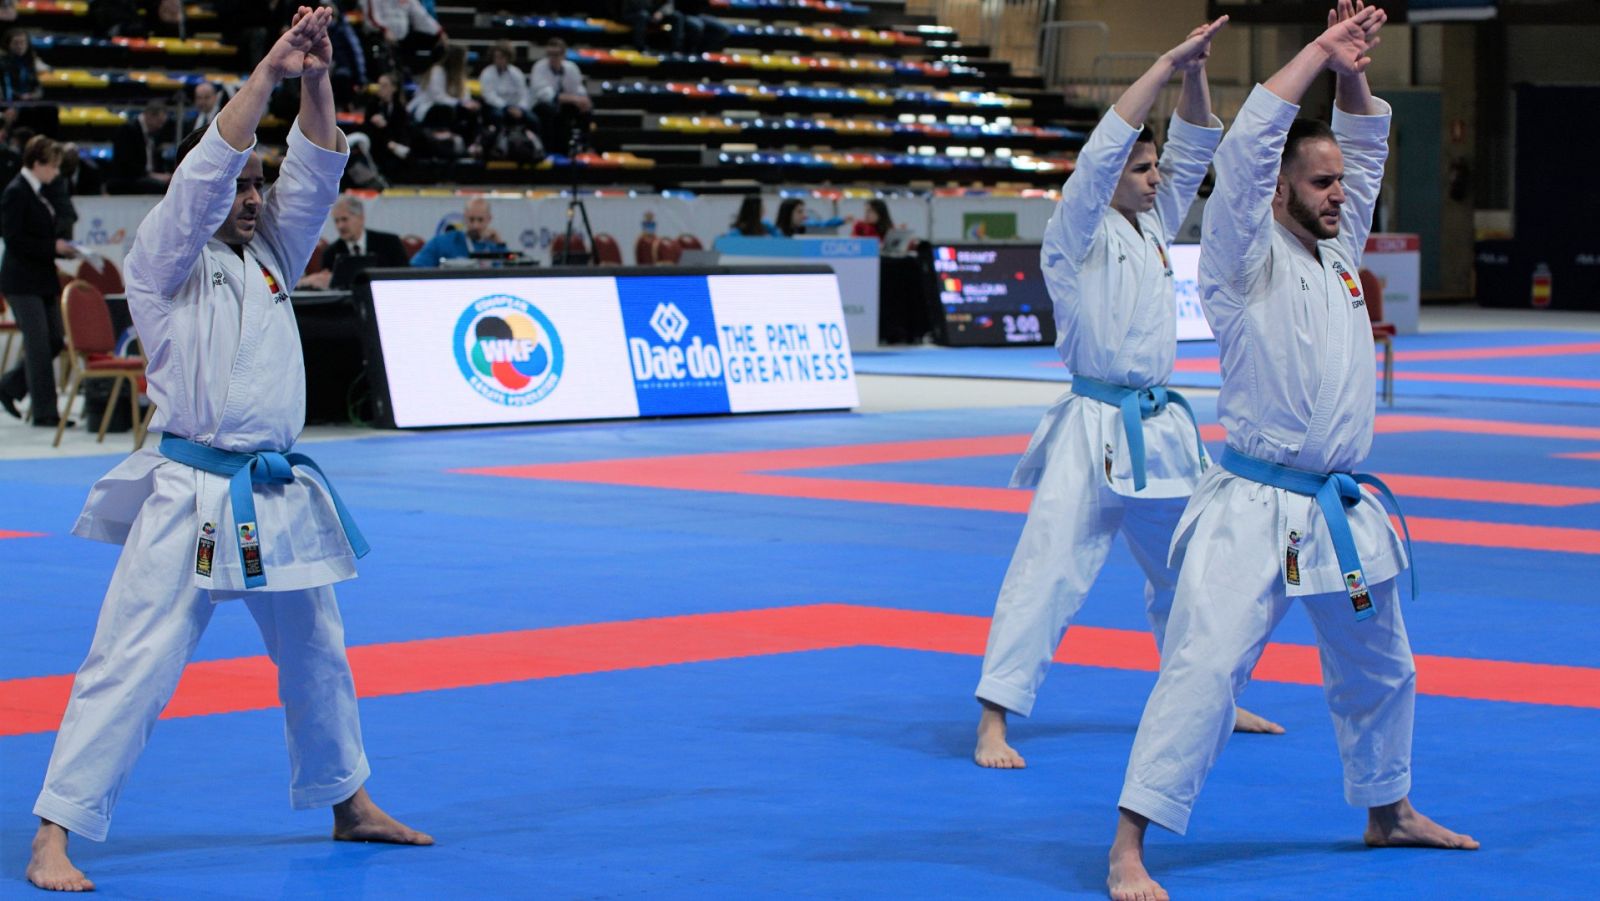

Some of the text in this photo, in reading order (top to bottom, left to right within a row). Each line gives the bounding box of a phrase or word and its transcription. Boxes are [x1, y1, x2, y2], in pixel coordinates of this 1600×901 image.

[821, 242, 861, 255] COACH
[480, 338, 534, 363] WKF
[721, 323, 843, 352] THE PATH TO
[728, 354, 849, 383] GREATNESS
